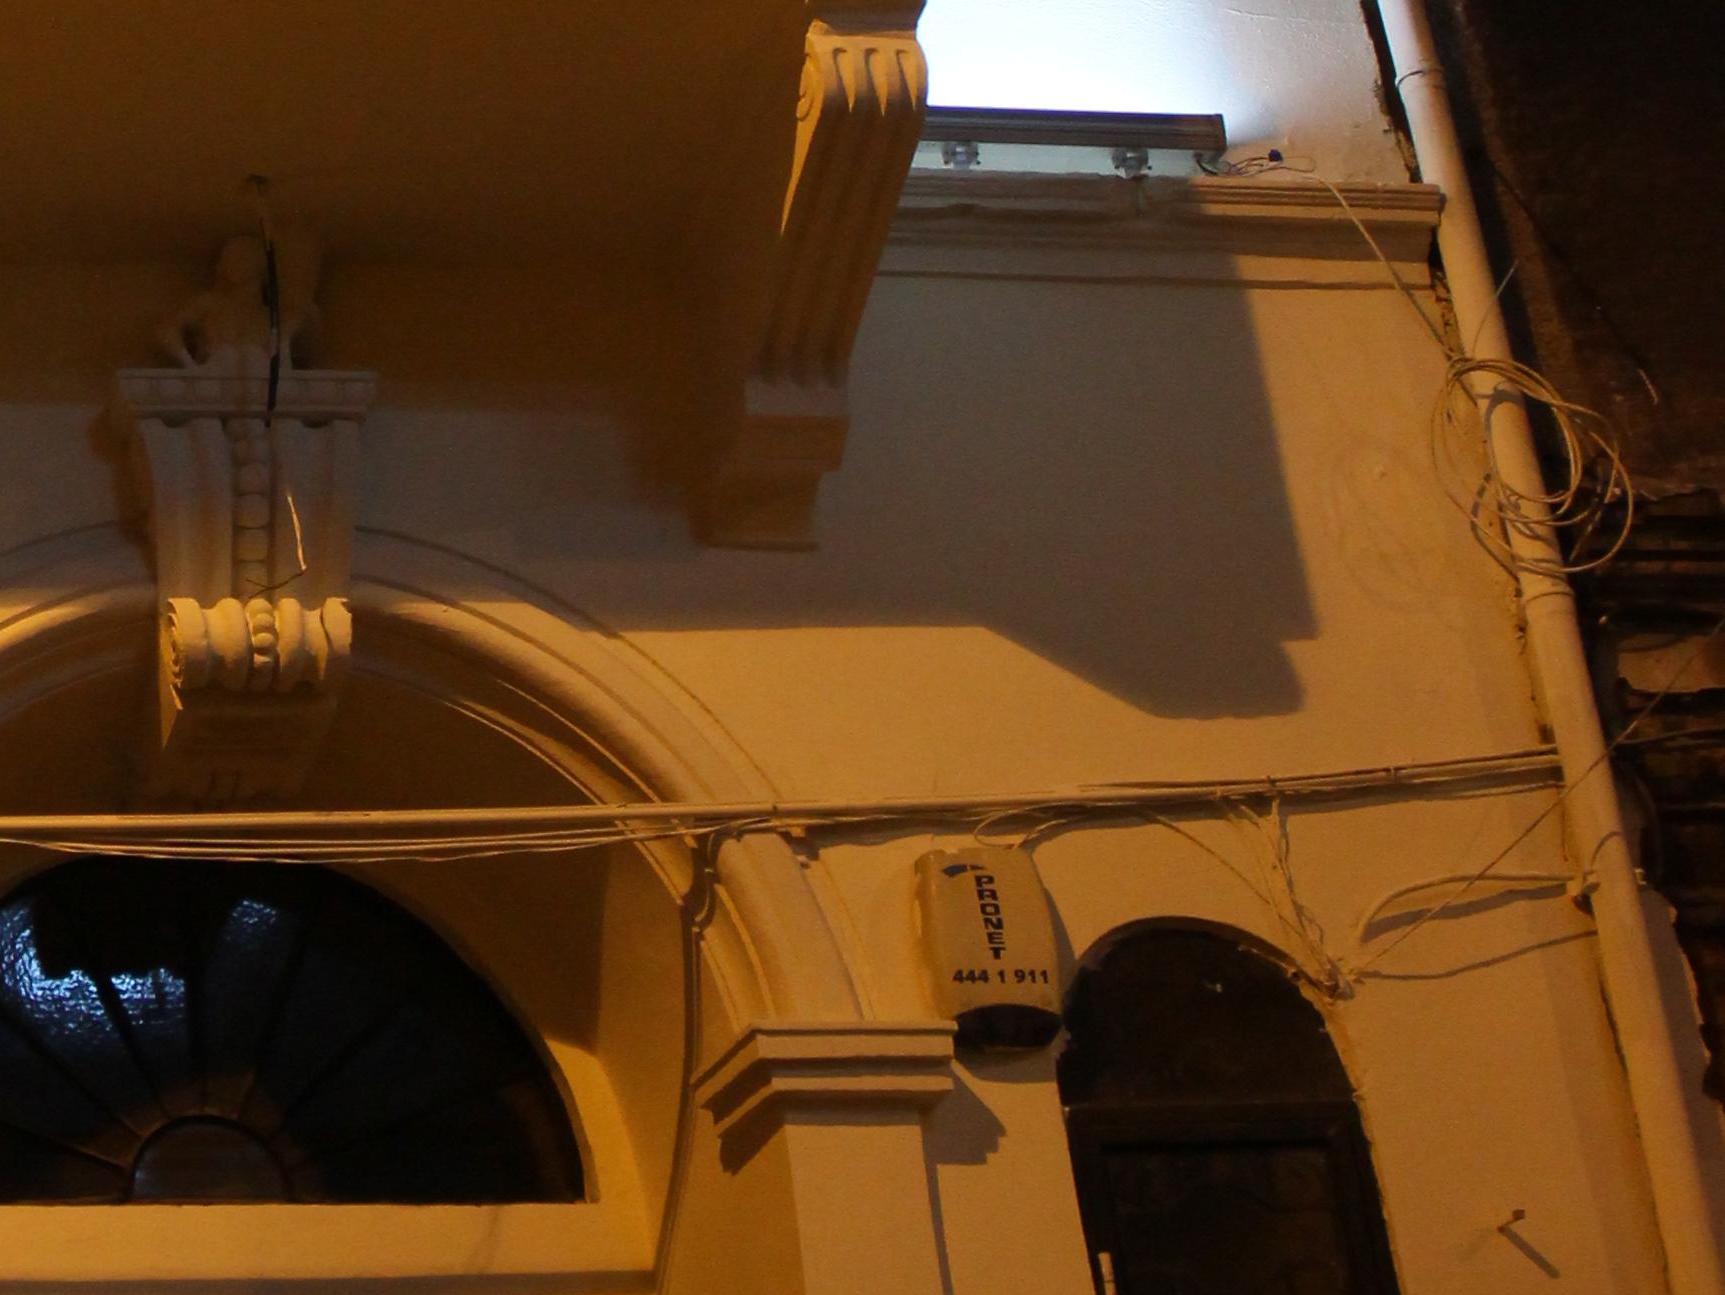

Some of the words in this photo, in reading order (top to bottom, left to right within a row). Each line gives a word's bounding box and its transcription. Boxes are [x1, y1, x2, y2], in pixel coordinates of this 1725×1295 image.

[974, 875, 1007, 960] PRONET
[953, 969, 989, 984] 444
[998, 969, 1006, 984] 1
[1014, 969, 1049, 984] 911
